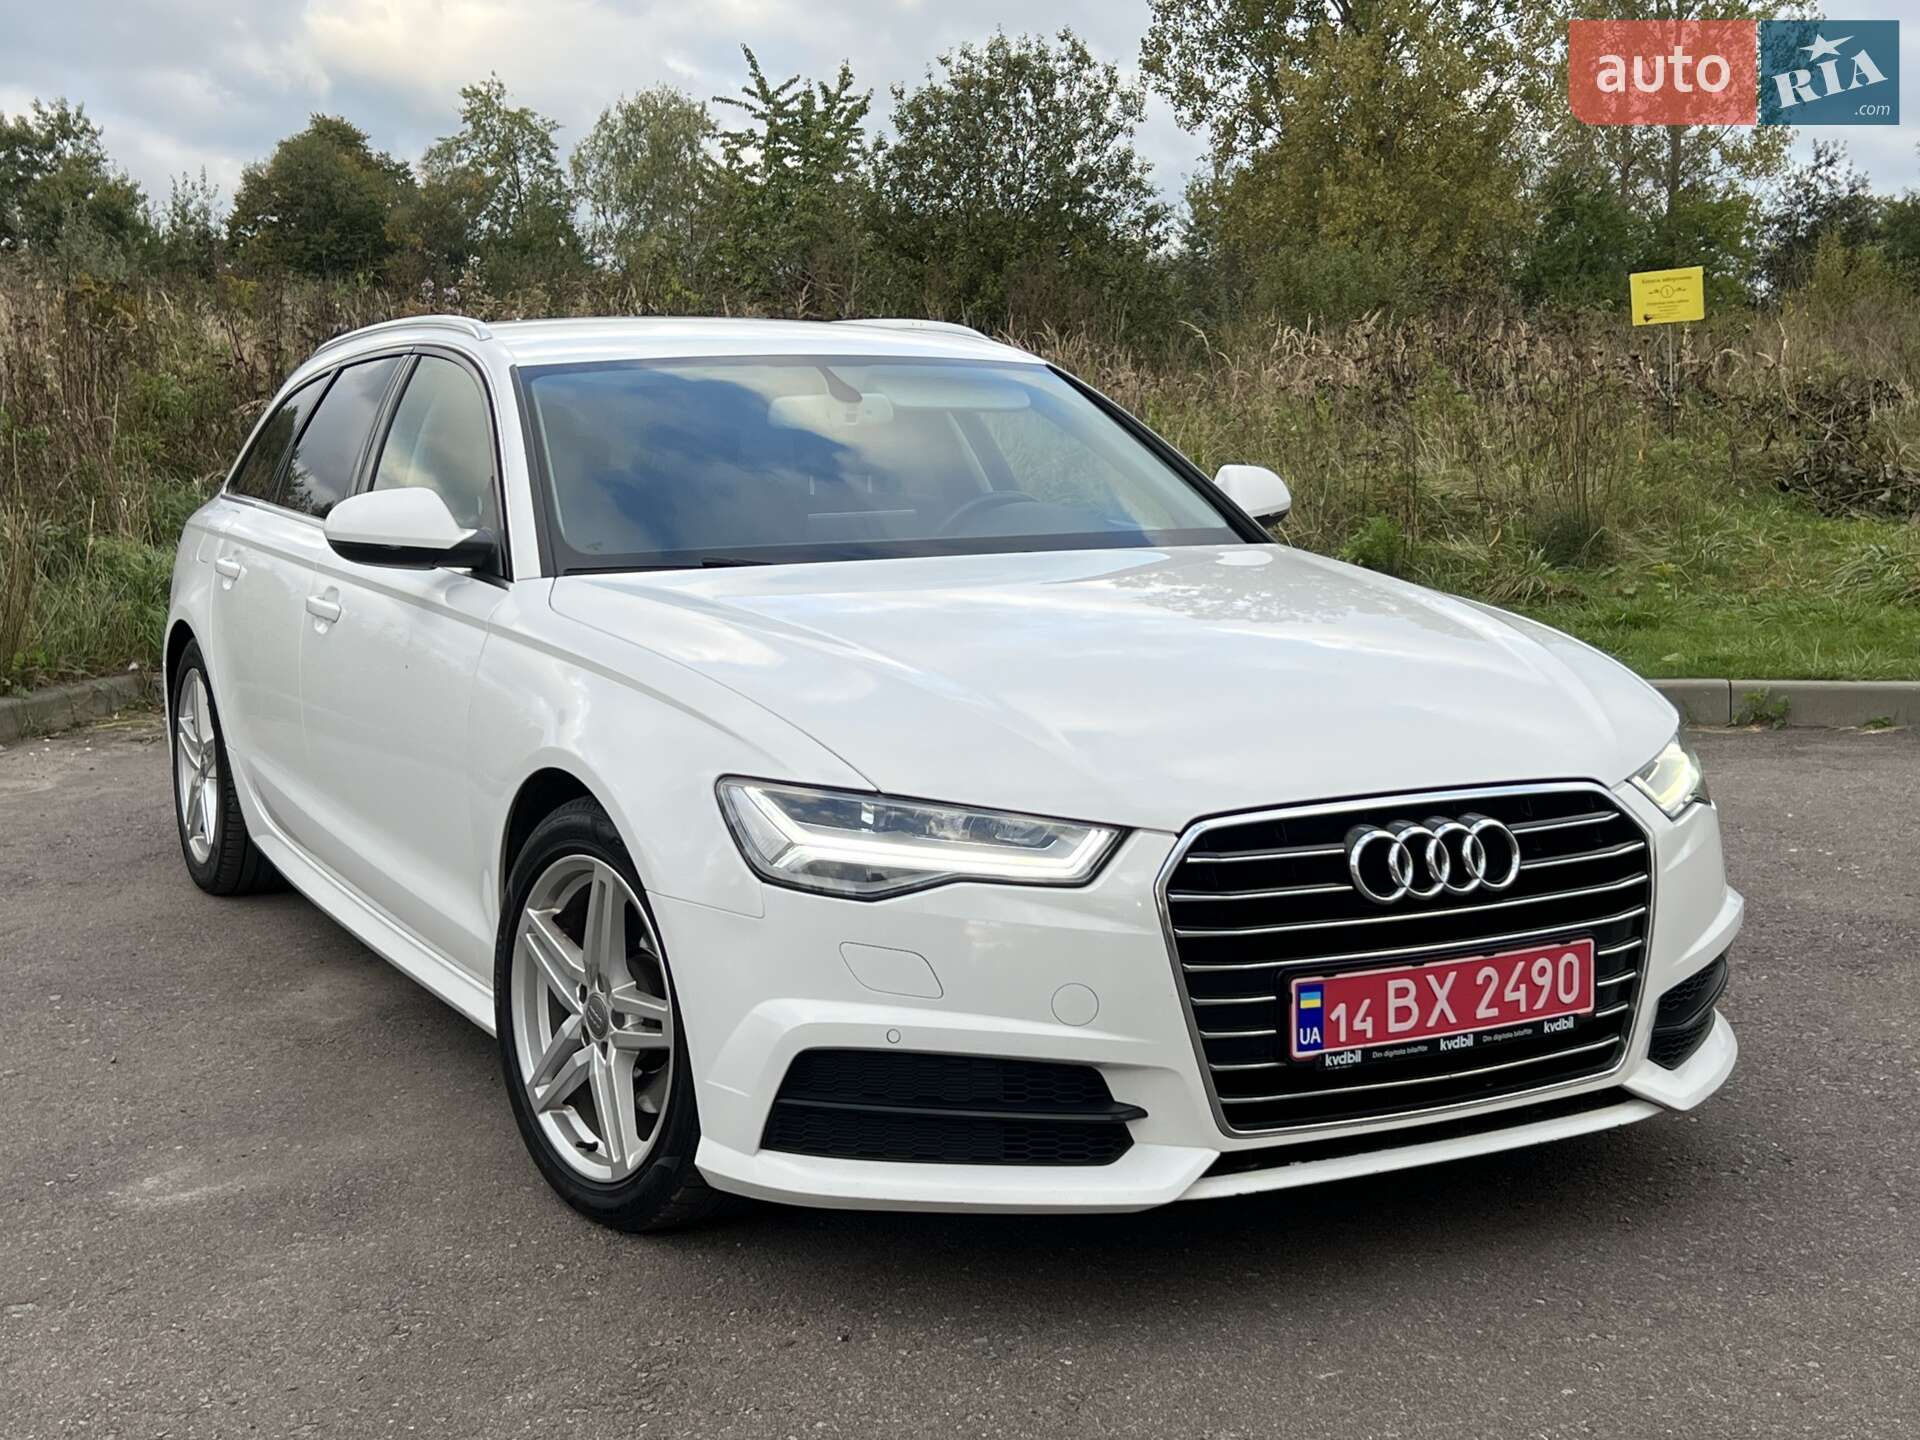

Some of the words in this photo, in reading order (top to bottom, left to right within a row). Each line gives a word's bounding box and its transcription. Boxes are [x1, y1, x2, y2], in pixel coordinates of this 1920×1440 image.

[1329, 998, 1373, 1043] 14
[1387, 971, 1457, 1033] BX
[1475, 952, 1580, 1020] 2490
[1299, 1026, 1321, 1045] UA
[1325, 1049, 1362, 1067] kvdbil
[1439, 1034, 1474, 1051] kvdbil
[1543, 1016, 1574, 1034] kvdbil
